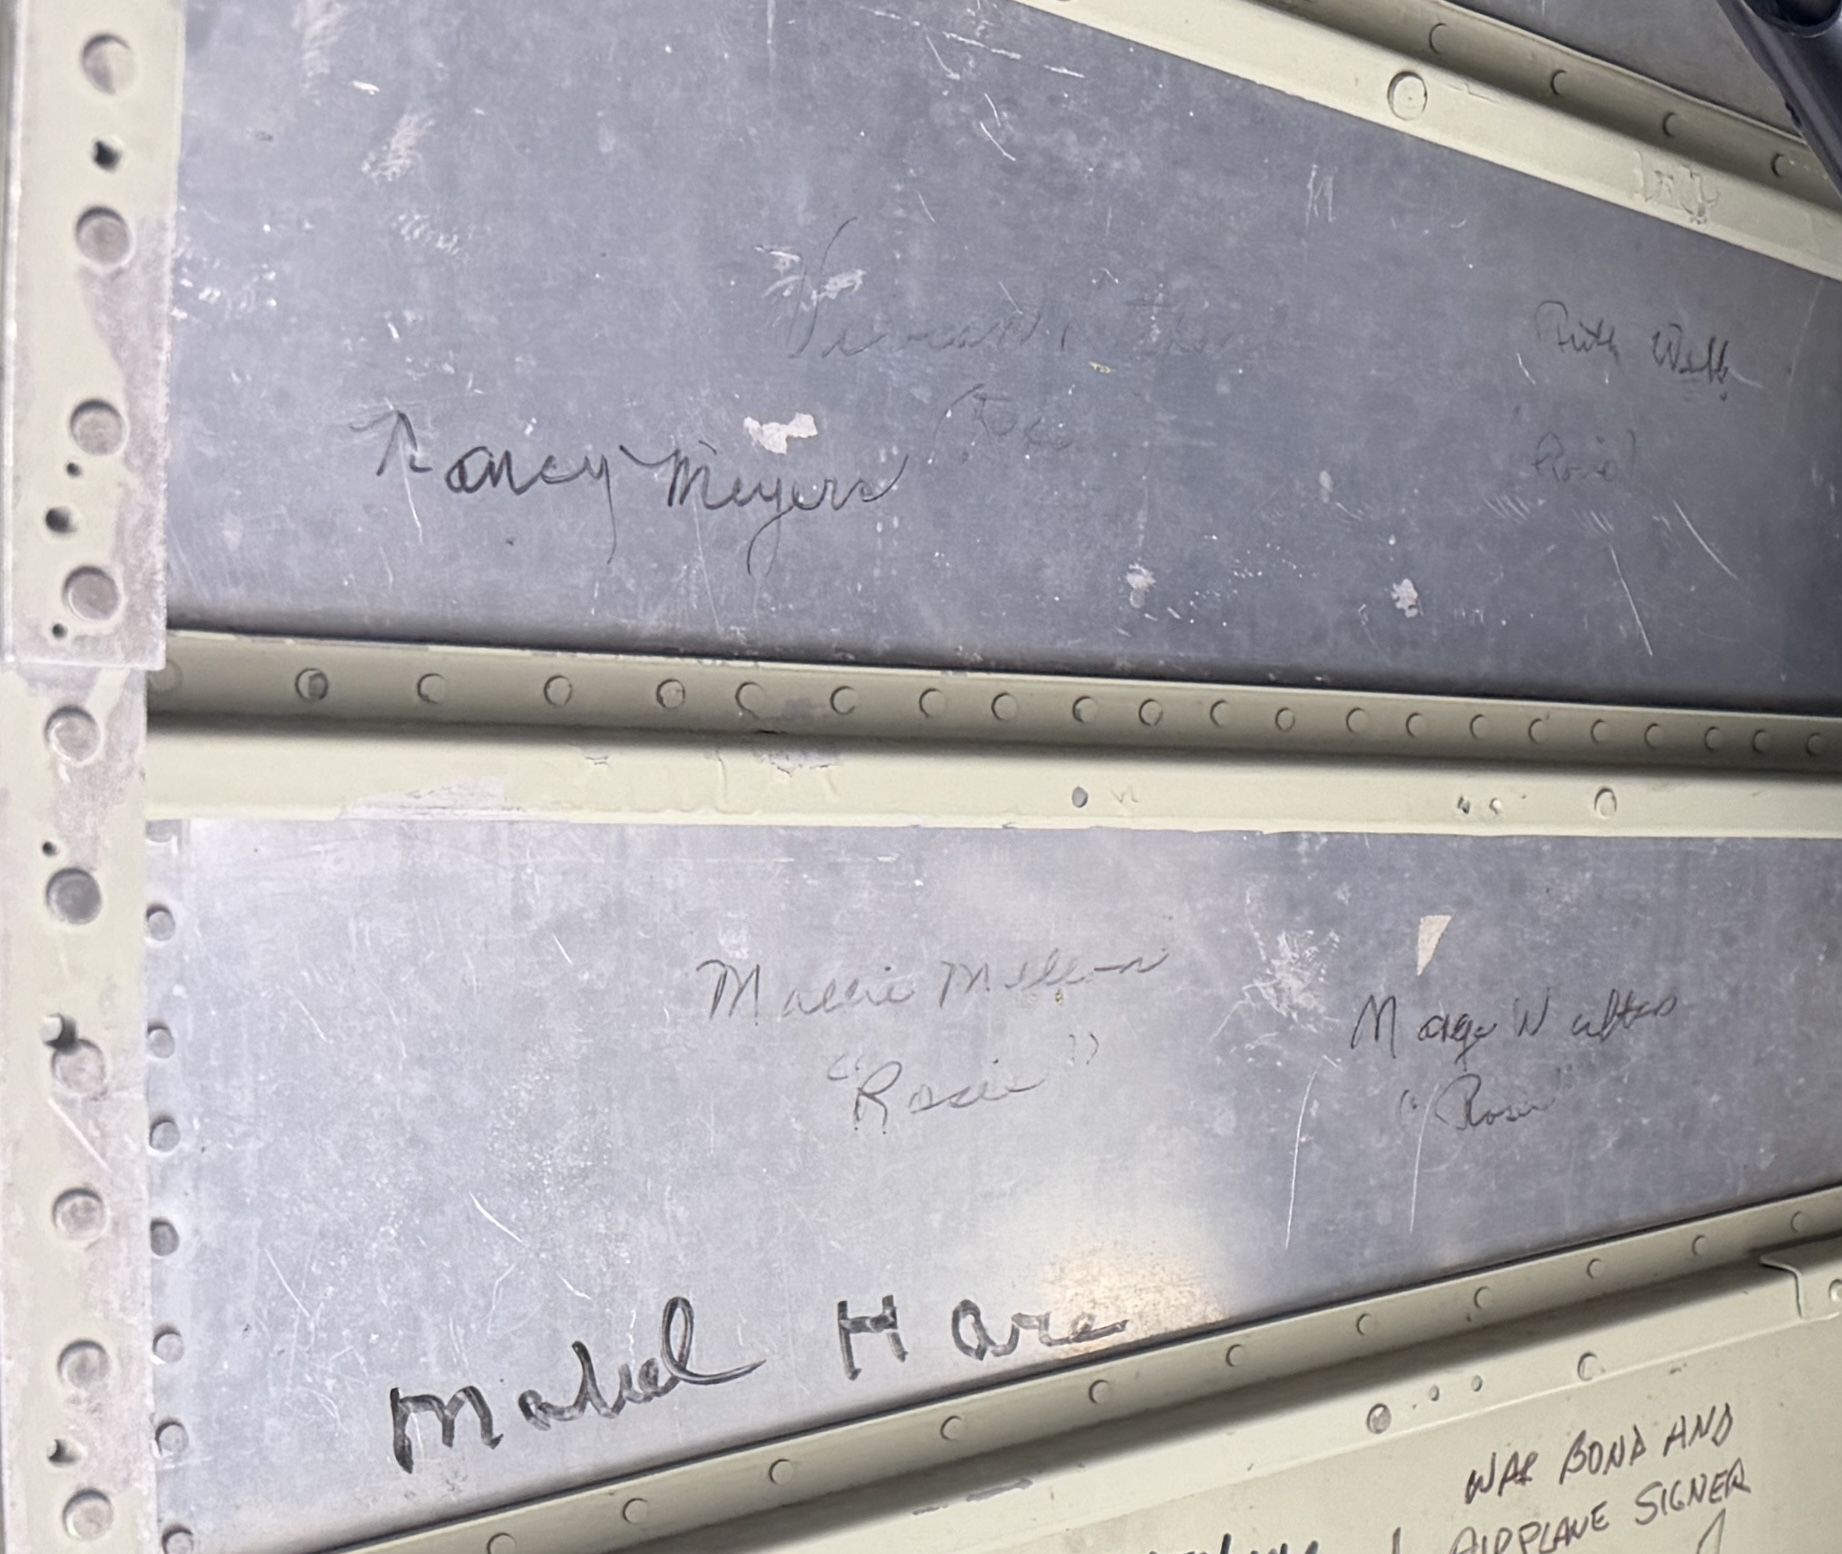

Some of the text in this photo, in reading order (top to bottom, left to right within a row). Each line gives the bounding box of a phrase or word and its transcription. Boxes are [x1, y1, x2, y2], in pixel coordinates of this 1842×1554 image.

[348, 409, 909, 574] Nancy Meyers
[390, 1294, 1128, 1475] Mabel Hare
[1464, 1401, 1735, 1506] WAR BOND AND
[1634, 1456, 1751, 1526] SIGNER
